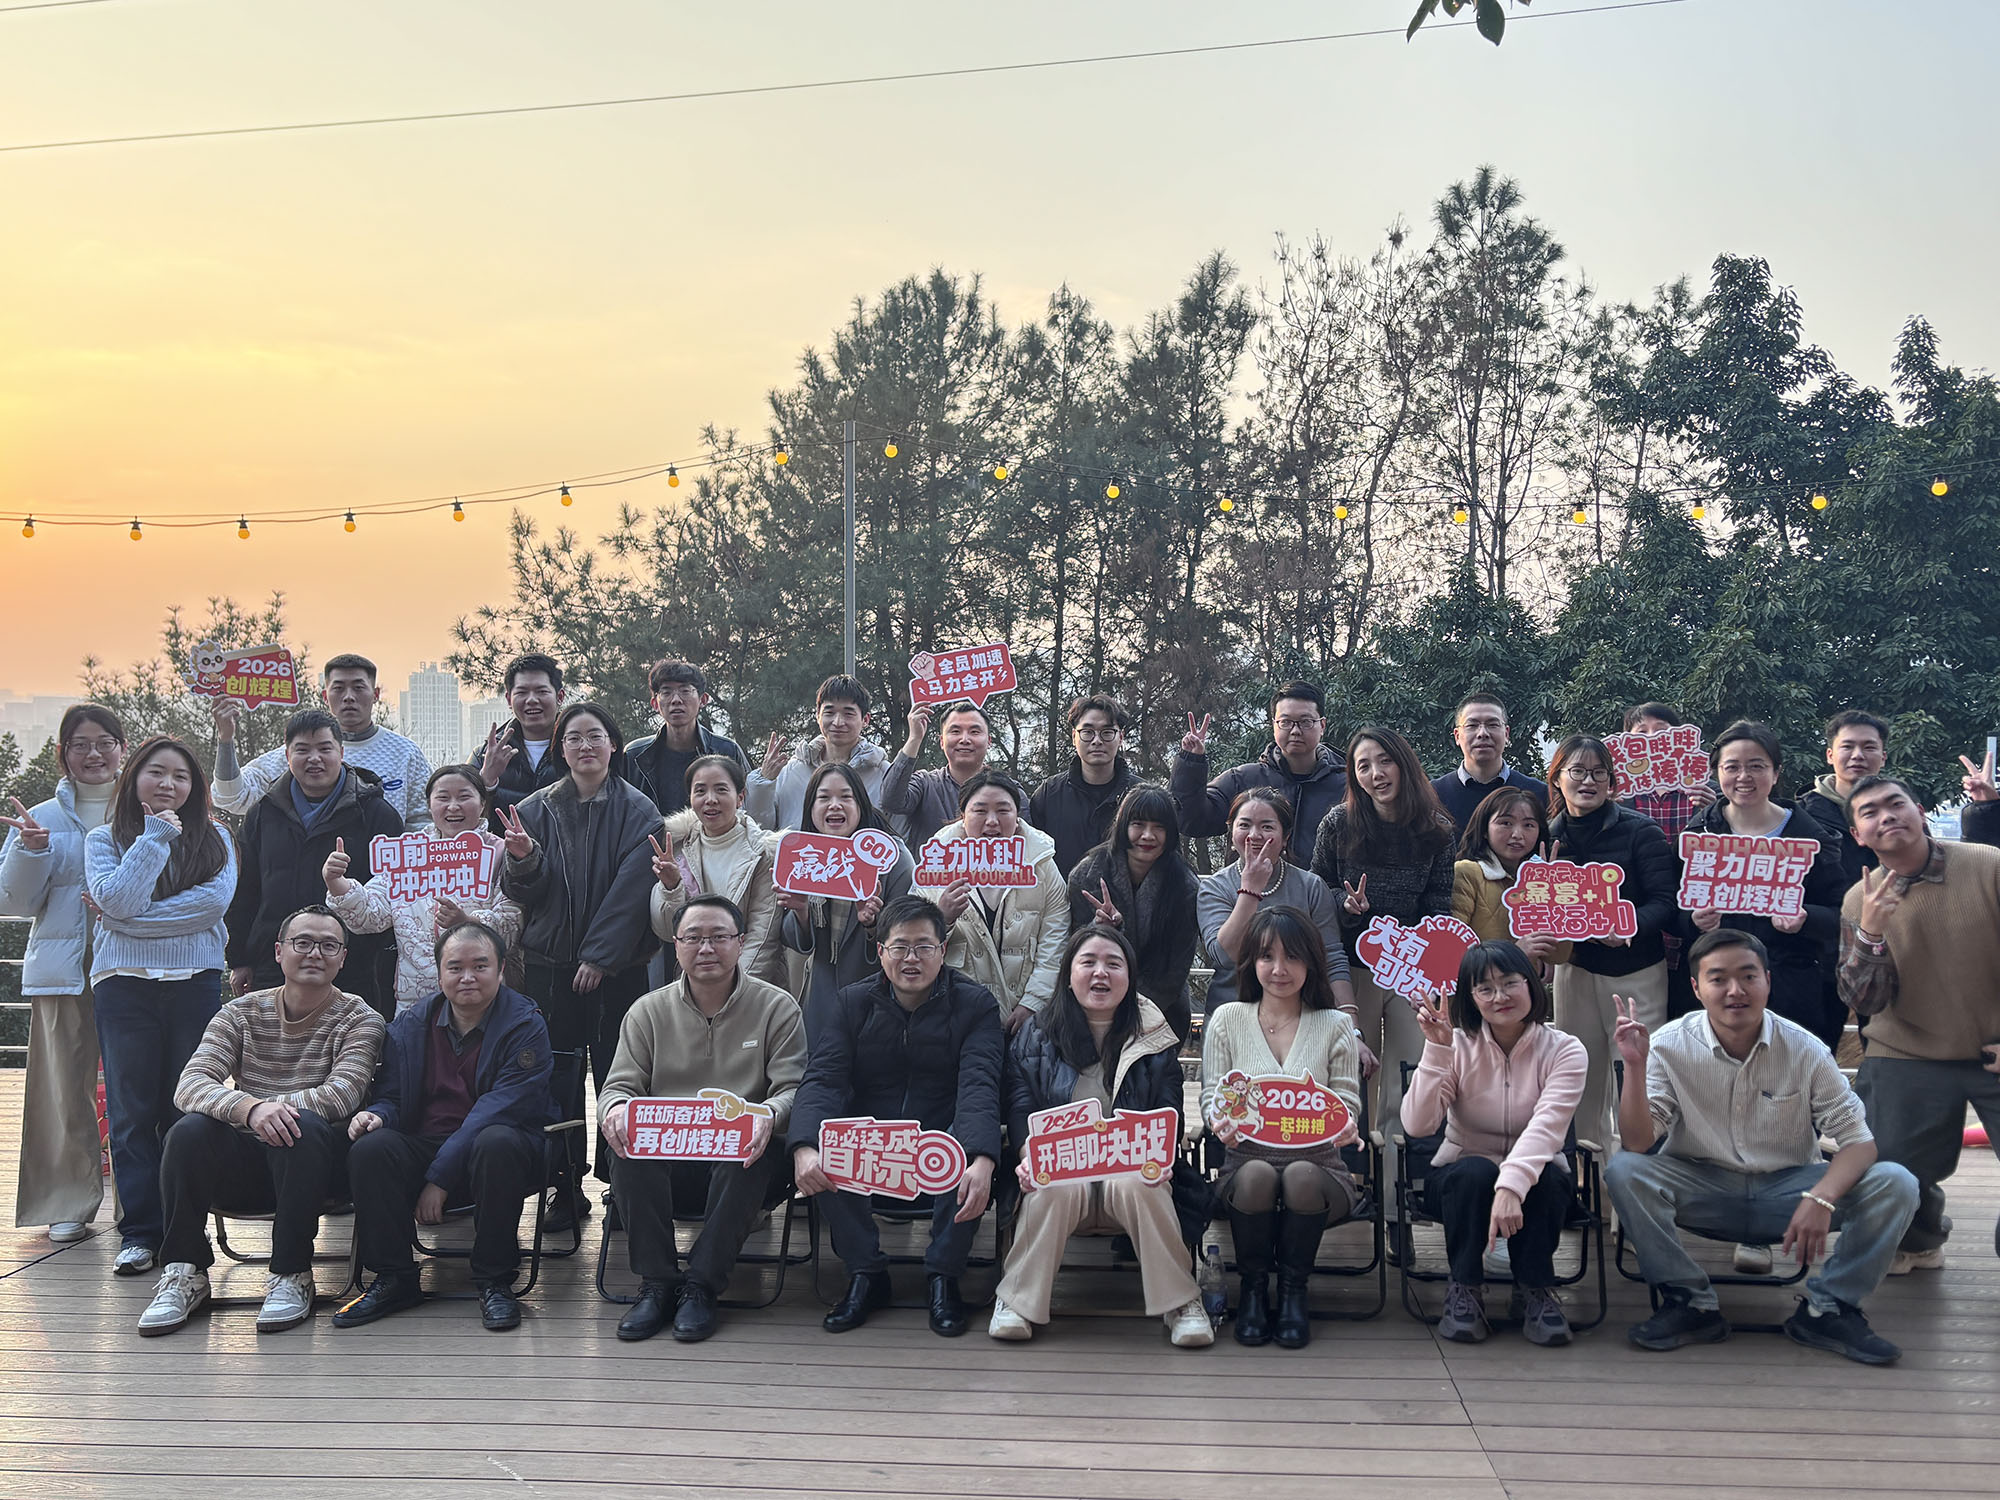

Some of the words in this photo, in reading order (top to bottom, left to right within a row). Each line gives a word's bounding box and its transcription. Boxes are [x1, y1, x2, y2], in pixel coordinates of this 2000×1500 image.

[237, 658, 291, 677] 2026
[938, 649, 1004, 676] 全员加速
[226, 675, 293, 699] 创辉煌
[927, 669, 995, 696] 马力全开
[375, 836, 428, 870] 向前
[429, 840, 468, 852] CHARGE
[429, 851, 479, 863] FORWARD
[860, 835, 893, 865] GO!
[925, 841, 1022, 873] 全力以赴!
[917, 869, 948, 884] GIVE
[970, 870, 1007, 884] YOUR
[1010, 868, 1035, 884] ALL
[1689, 850, 1806, 883] 聚力同行
[1684, 880, 1801, 914] 再创辉煌
[1366, 919, 1431, 966] 大有
[1375, 951, 1433, 1001] 可为
[1265, 1088, 1326, 1112] 2026
[635, 1104, 713, 1125] 砥砺奋进
[1042, 1105, 1089, 1134] 2026
[1265, 1116, 1326, 1135] 一起拼搏
[633, 1127, 742, 1156] 再创辉煌
[823, 1129, 919, 1154] 势必达成
[1037, 1117, 1168, 1174] 开局即决战
[823, 1147, 918, 1193] 目标
